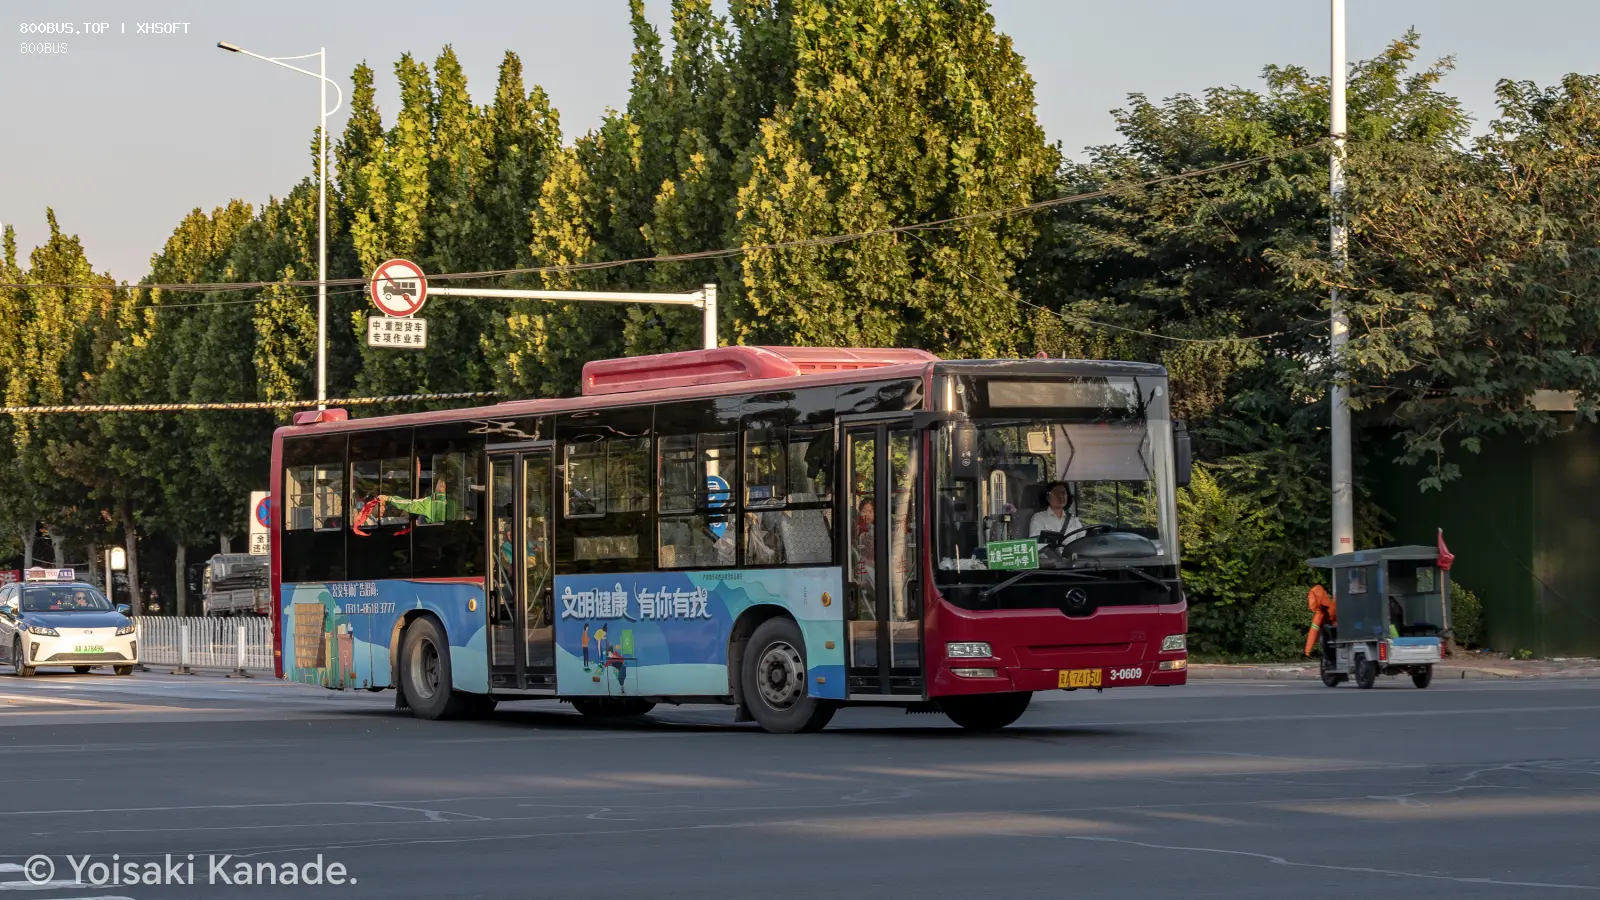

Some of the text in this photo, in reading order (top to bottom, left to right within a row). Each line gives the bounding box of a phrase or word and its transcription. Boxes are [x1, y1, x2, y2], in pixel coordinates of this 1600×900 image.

[373, 332, 422, 344] 专项作业车
[1014, 555, 1029, 567] 小学
[1028, 545, 1035, 563] 1
[561, 582, 713, 621] 文明健康 有你有我
[1110, 667, 1143, 681] 3-0609
